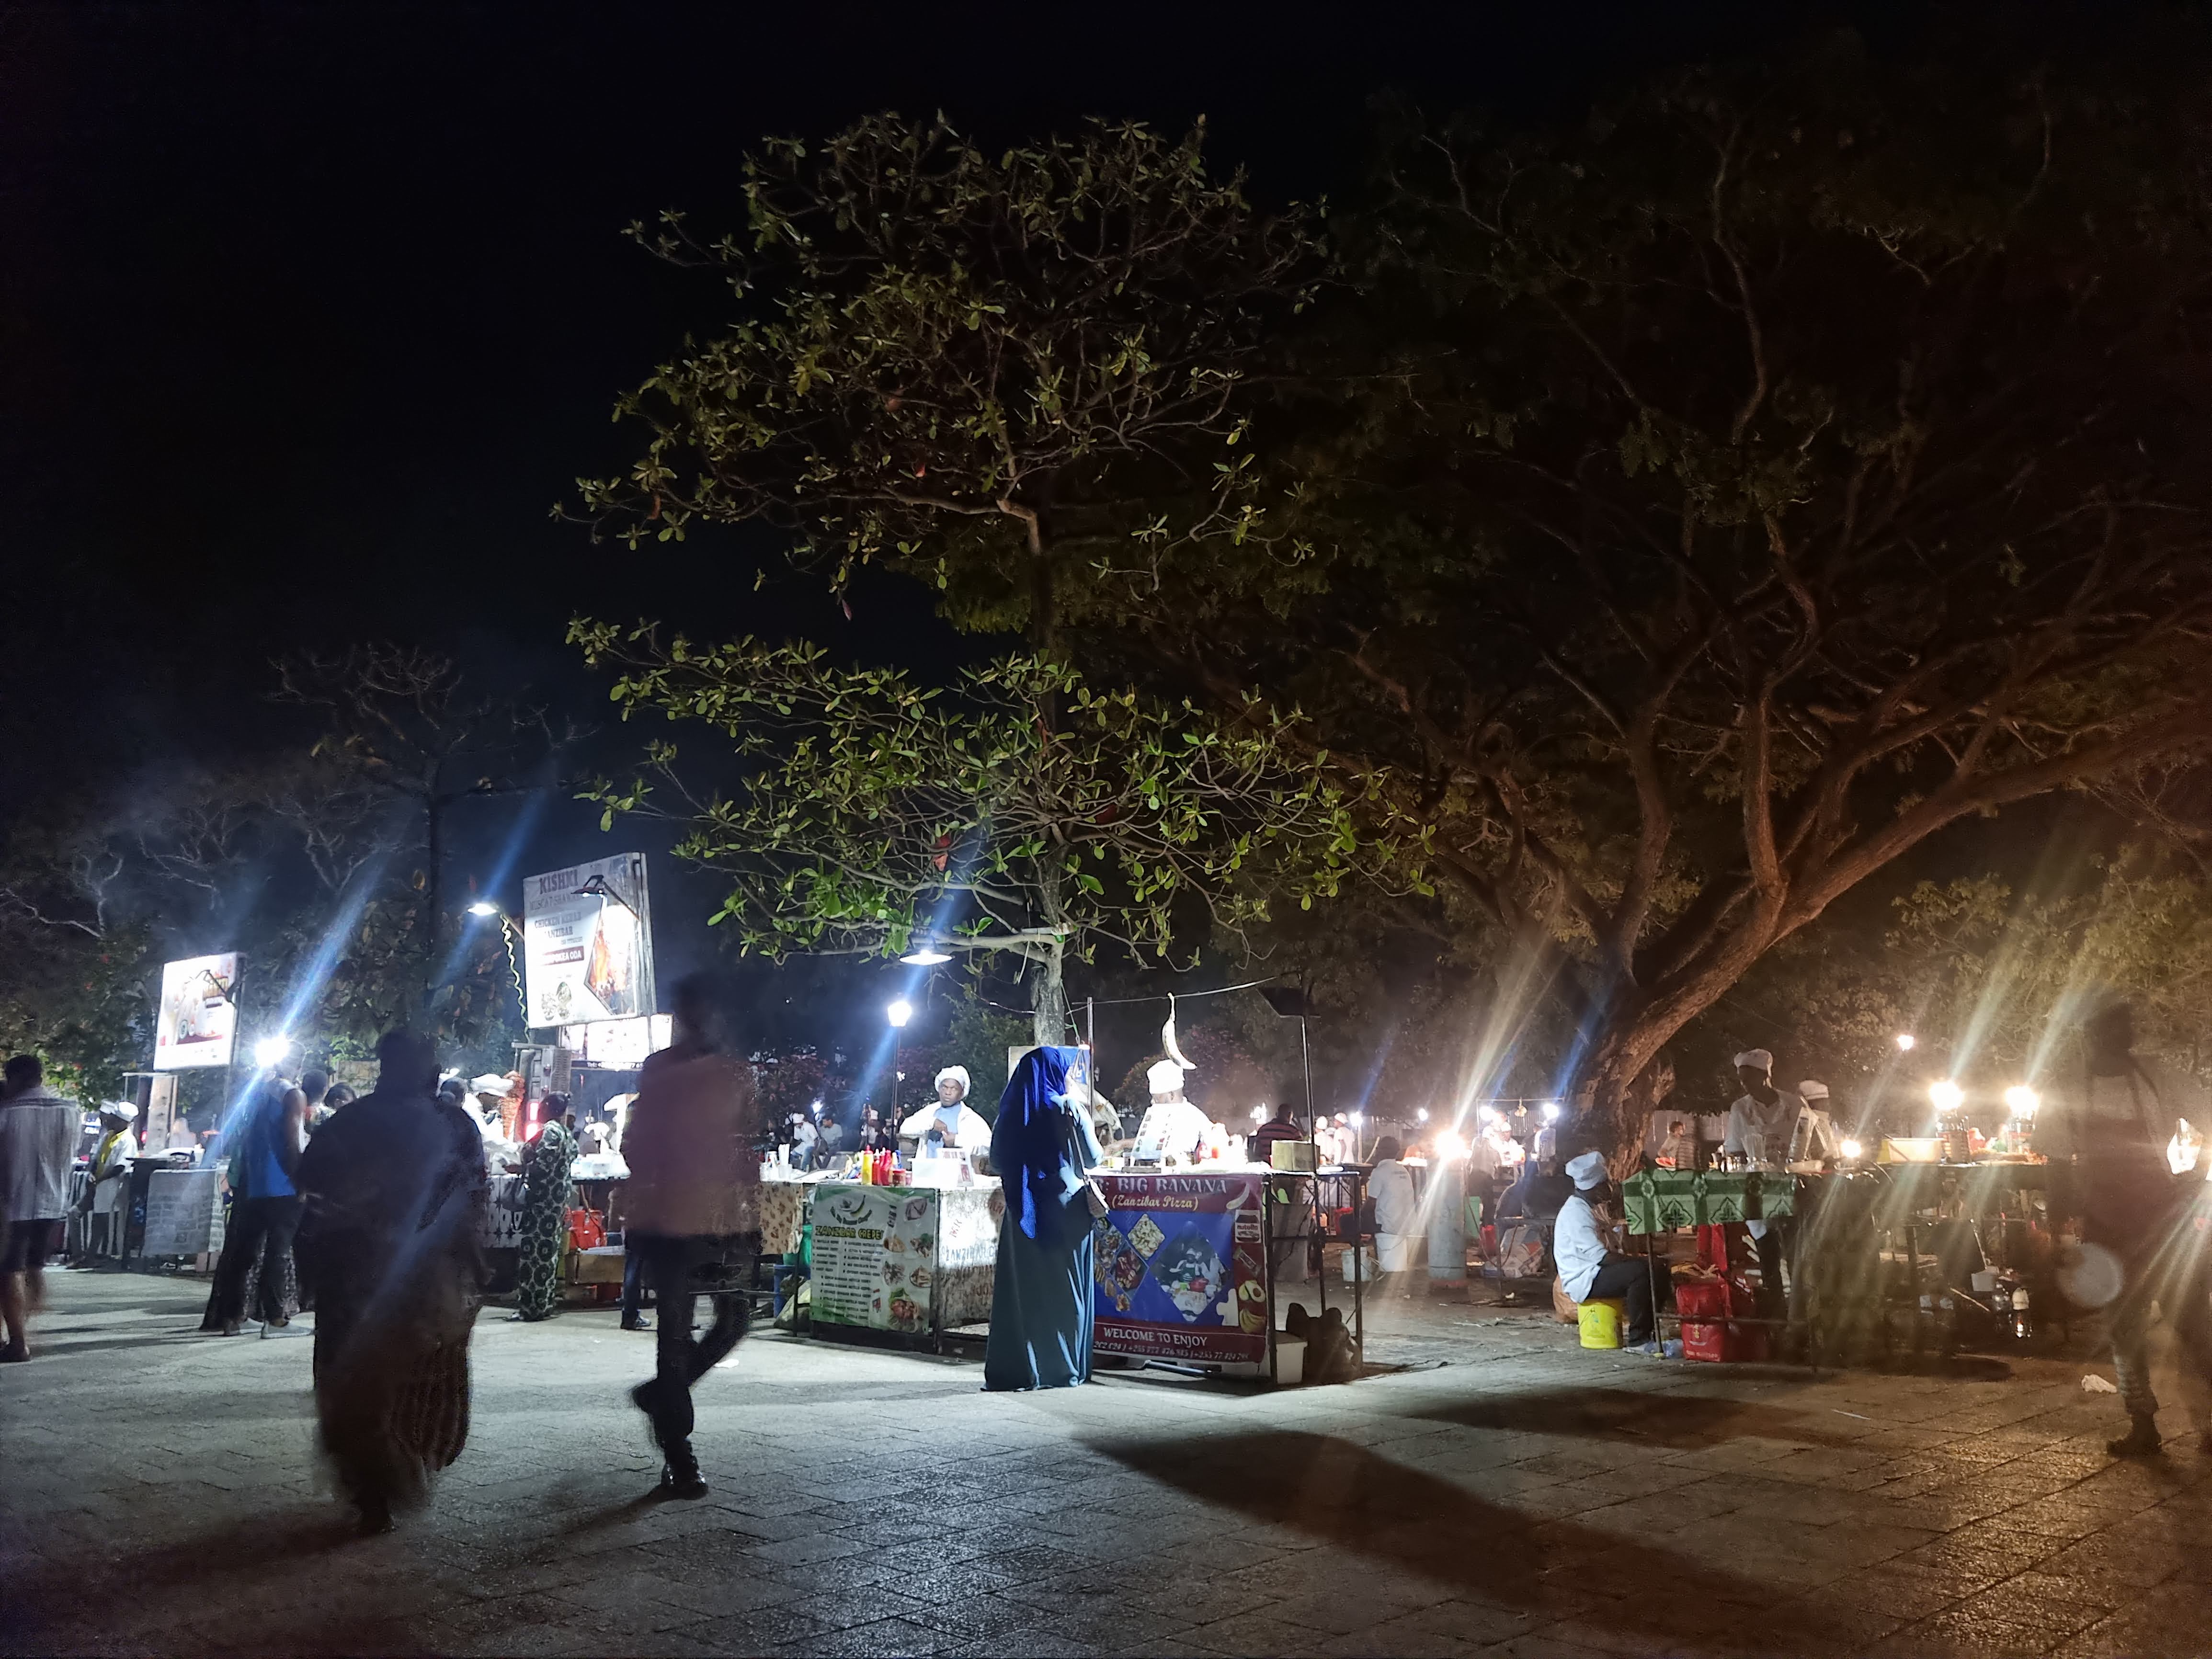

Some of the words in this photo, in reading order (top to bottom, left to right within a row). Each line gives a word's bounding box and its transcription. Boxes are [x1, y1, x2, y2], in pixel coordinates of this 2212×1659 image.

[570, 950, 582, 960] ODA
[1117, 1177, 1147, 1193] BIG
[1155, 1177, 1227, 1193] BANANA
[1111, 1194, 1160, 1208] (Zanzibar
[1162, 1195, 1199, 1211] Pizza)
[1103, 1327, 1155, 1341] WELCOME
[1157, 1332, 1170, 1342] TO
[1174, 1334, 1208, 1348] ENJOY
